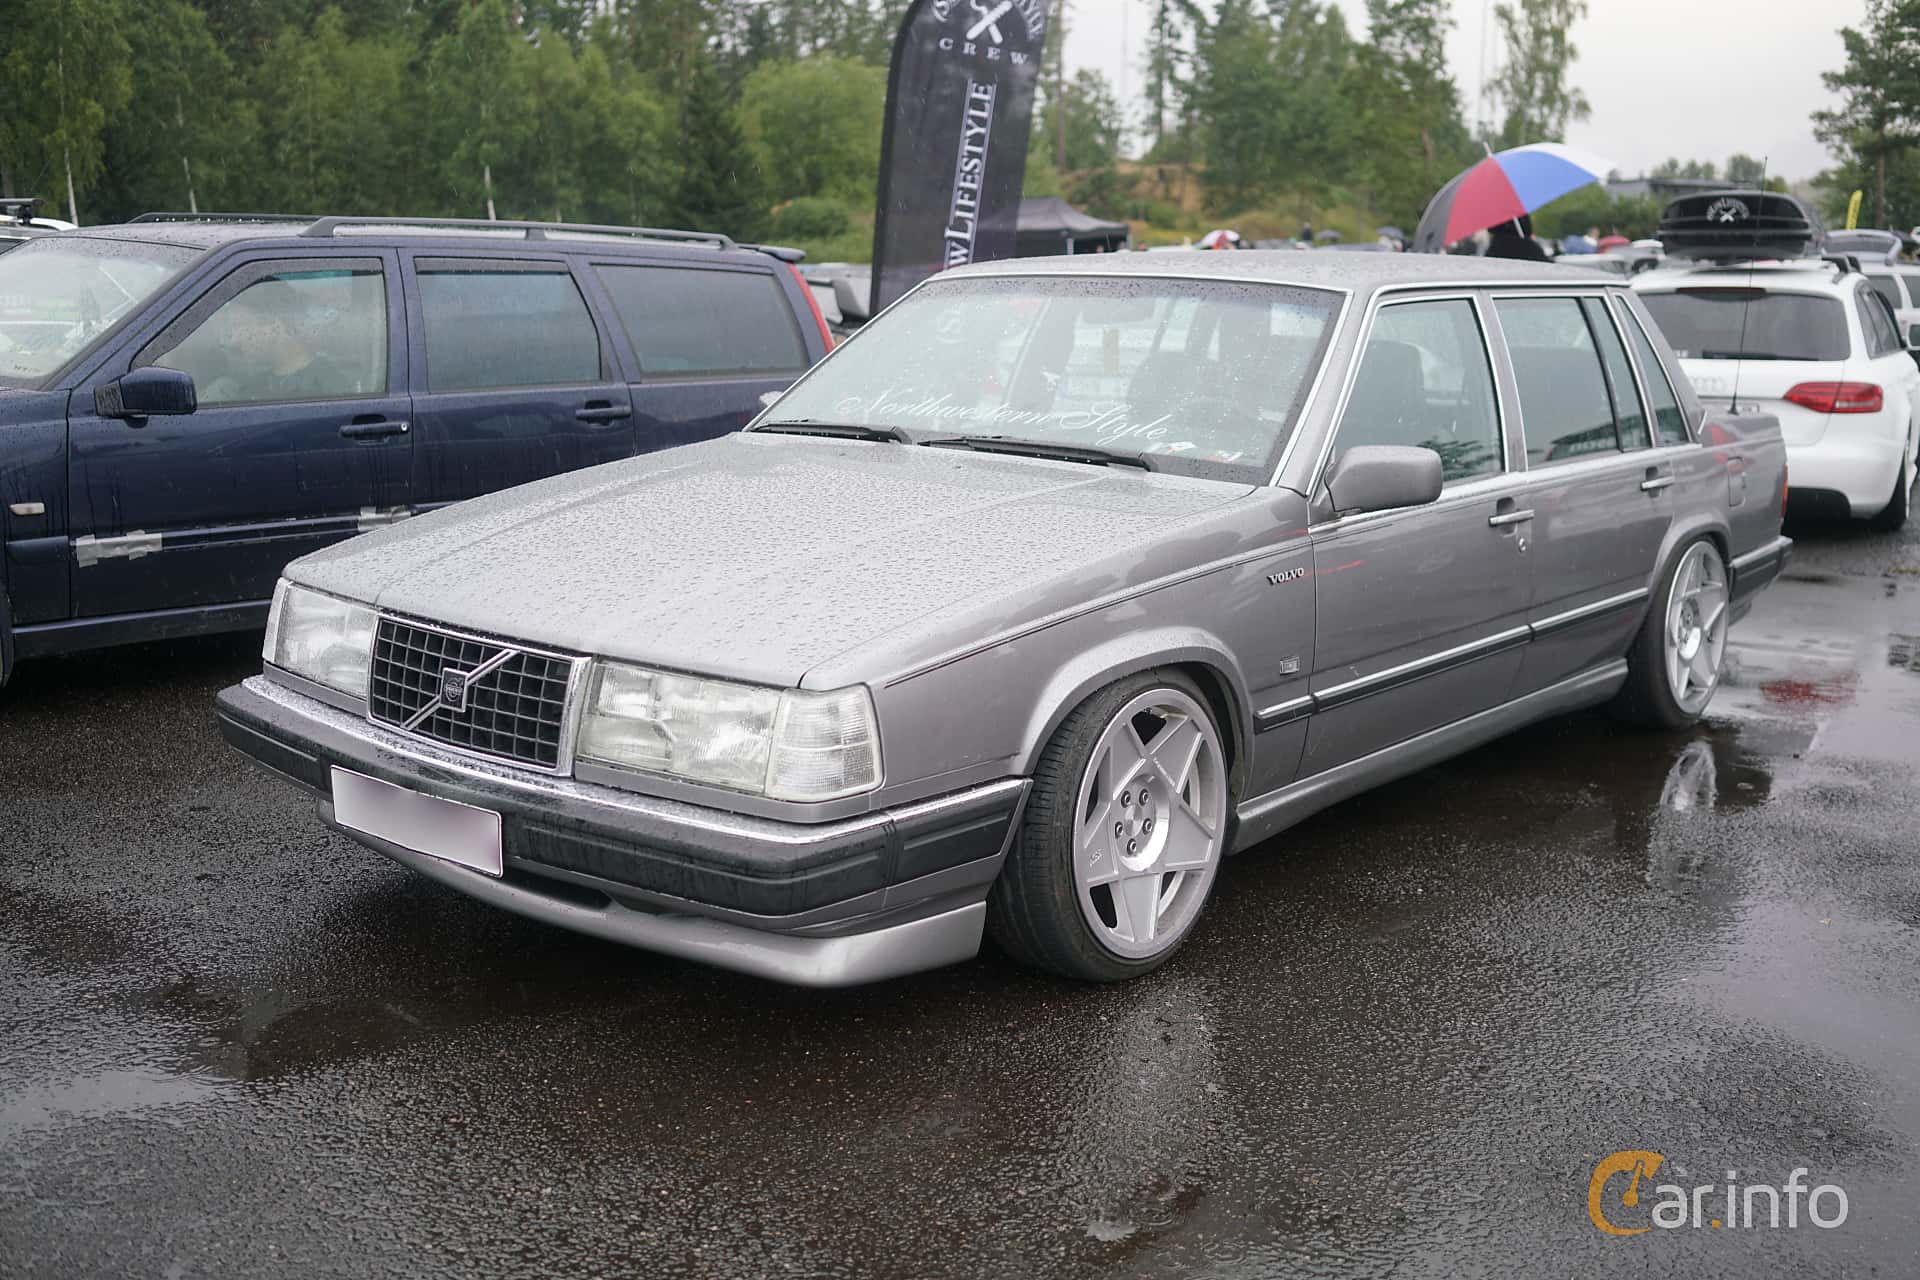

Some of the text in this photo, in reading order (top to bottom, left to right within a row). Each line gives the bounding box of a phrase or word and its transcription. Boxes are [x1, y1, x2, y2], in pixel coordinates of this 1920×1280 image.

[939, 37, 1029, 64] CREW
[836, 384, 1172, 445] Northwetern Style
[1267, 567, 1304, 584] VOLVO
